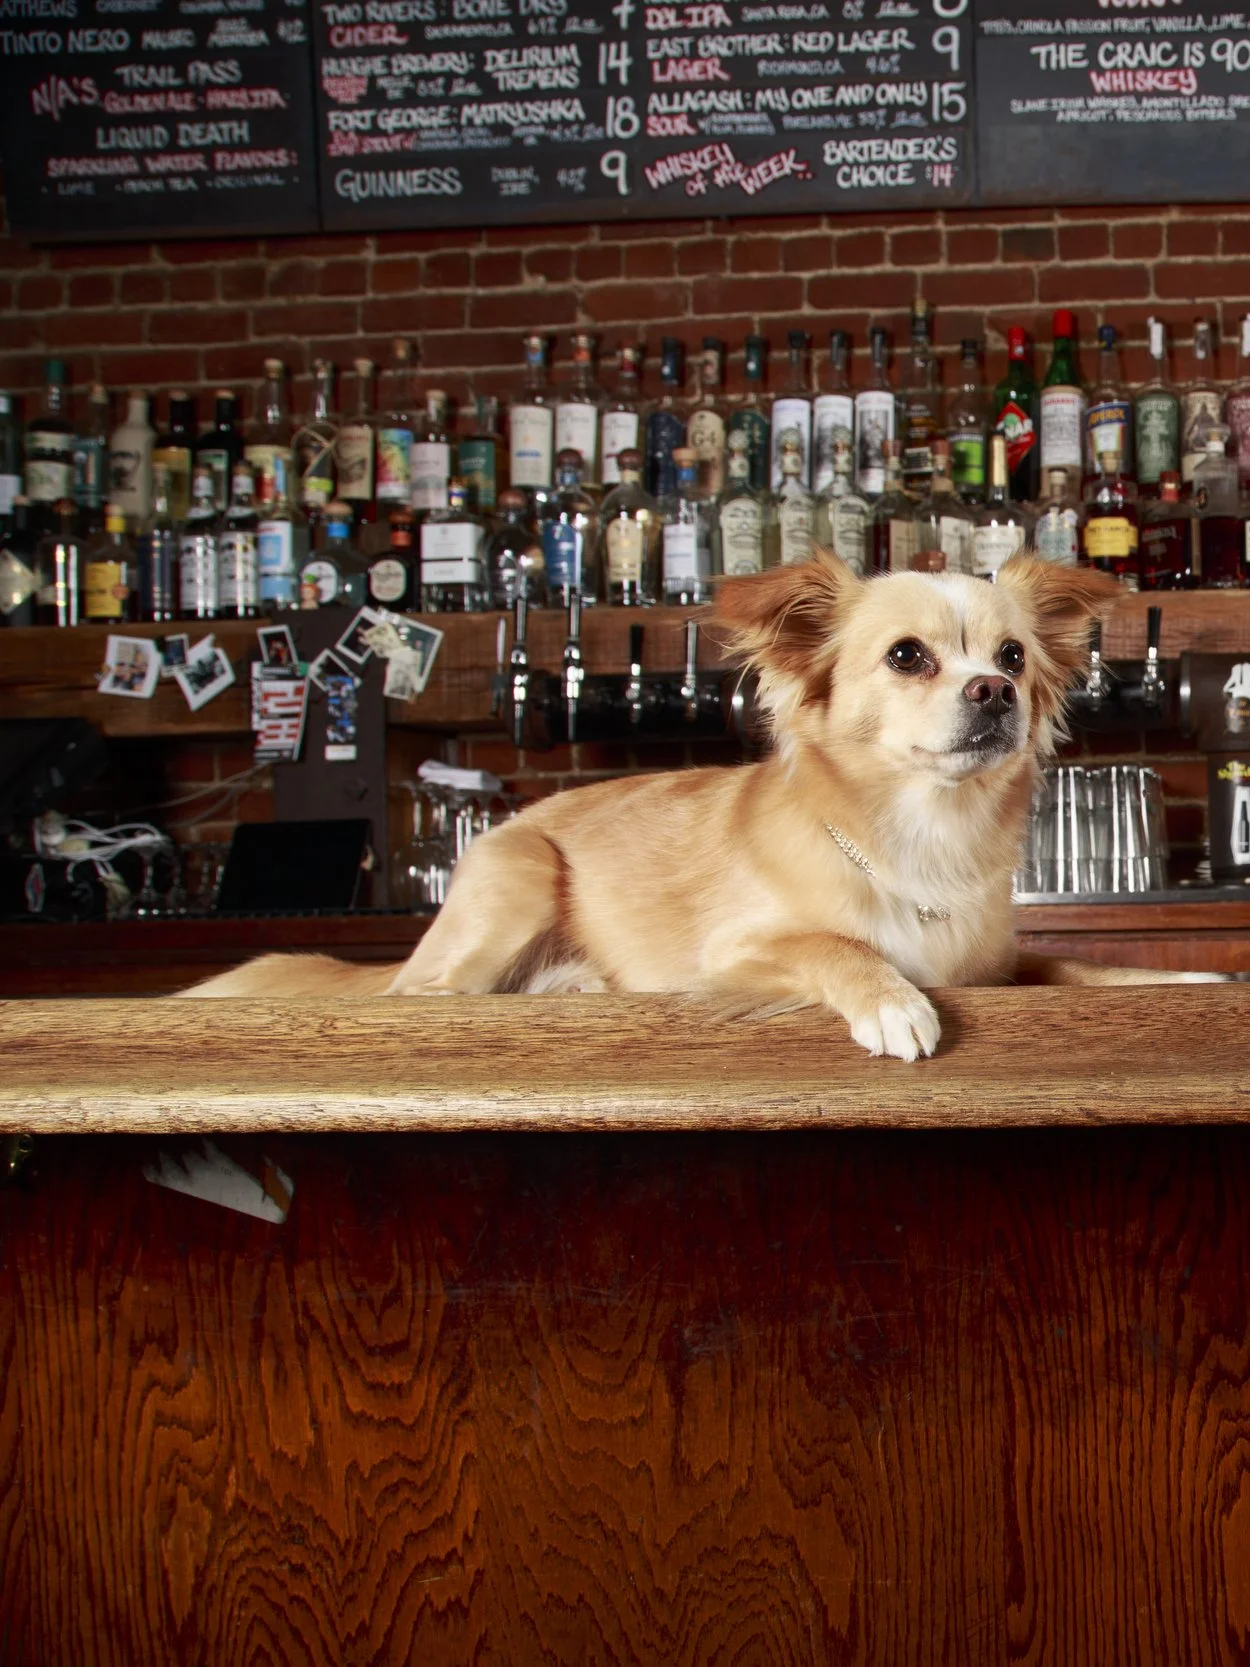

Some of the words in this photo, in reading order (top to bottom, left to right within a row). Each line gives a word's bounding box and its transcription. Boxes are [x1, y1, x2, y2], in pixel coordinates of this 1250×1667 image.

[320, 4, 363, 25] TWO
[0, 31, 62, 55] TINTO
[67, 28, 131, 53] NERO
[329, 23, 409, 48] CIDER
[646, 37, 696, 60] EAST
[792, 31, 835, 54] RED
[837, 27, 916, 53] LAGER
[931, 25, 960, 72] 9
[484, 43, 582, 73] DELIRIUM
[598, 41, 634, 86] 14
[652, 57, 732, 83] LAGER
[1029, 42, 1090, 70] THE
[1097, 41, 1179, 70] CRAIC
[1183, 41, 1206, 68] IS
[114, 64, 183, 87] TRAIL
[188, 58, 243, 84] PASS
[491, 66, 580, 91] TREMENS
[1089, 66, 1198, 96] WHISKEY
[755, 86, 791, 113] MY
[791, 85, 834, 111] ONE
[834, 83, 874, 107] AND
[875, 81, 928, 107] ONLY
[931, 81, 967, 123] 15
[326, 109, 377, 132] FORT
[606, 95, 641, 140] 18
[646, 113, 698, 137] SOUR
[96, 125, 170, 149] LIQUID
[176, 120, 250, 146] DEATH
[144, 153, 207, 174] WATER
[822, 134, 958, 167] BARTENDER'S
[334, 167, 463, 203] GUINNESS
[600, 150, 632, 196] 9
[644, 141, 736, 190] WHISKEY
[836, 163, 916, 189] CHOICE
[684, 171, 710, 197] of
